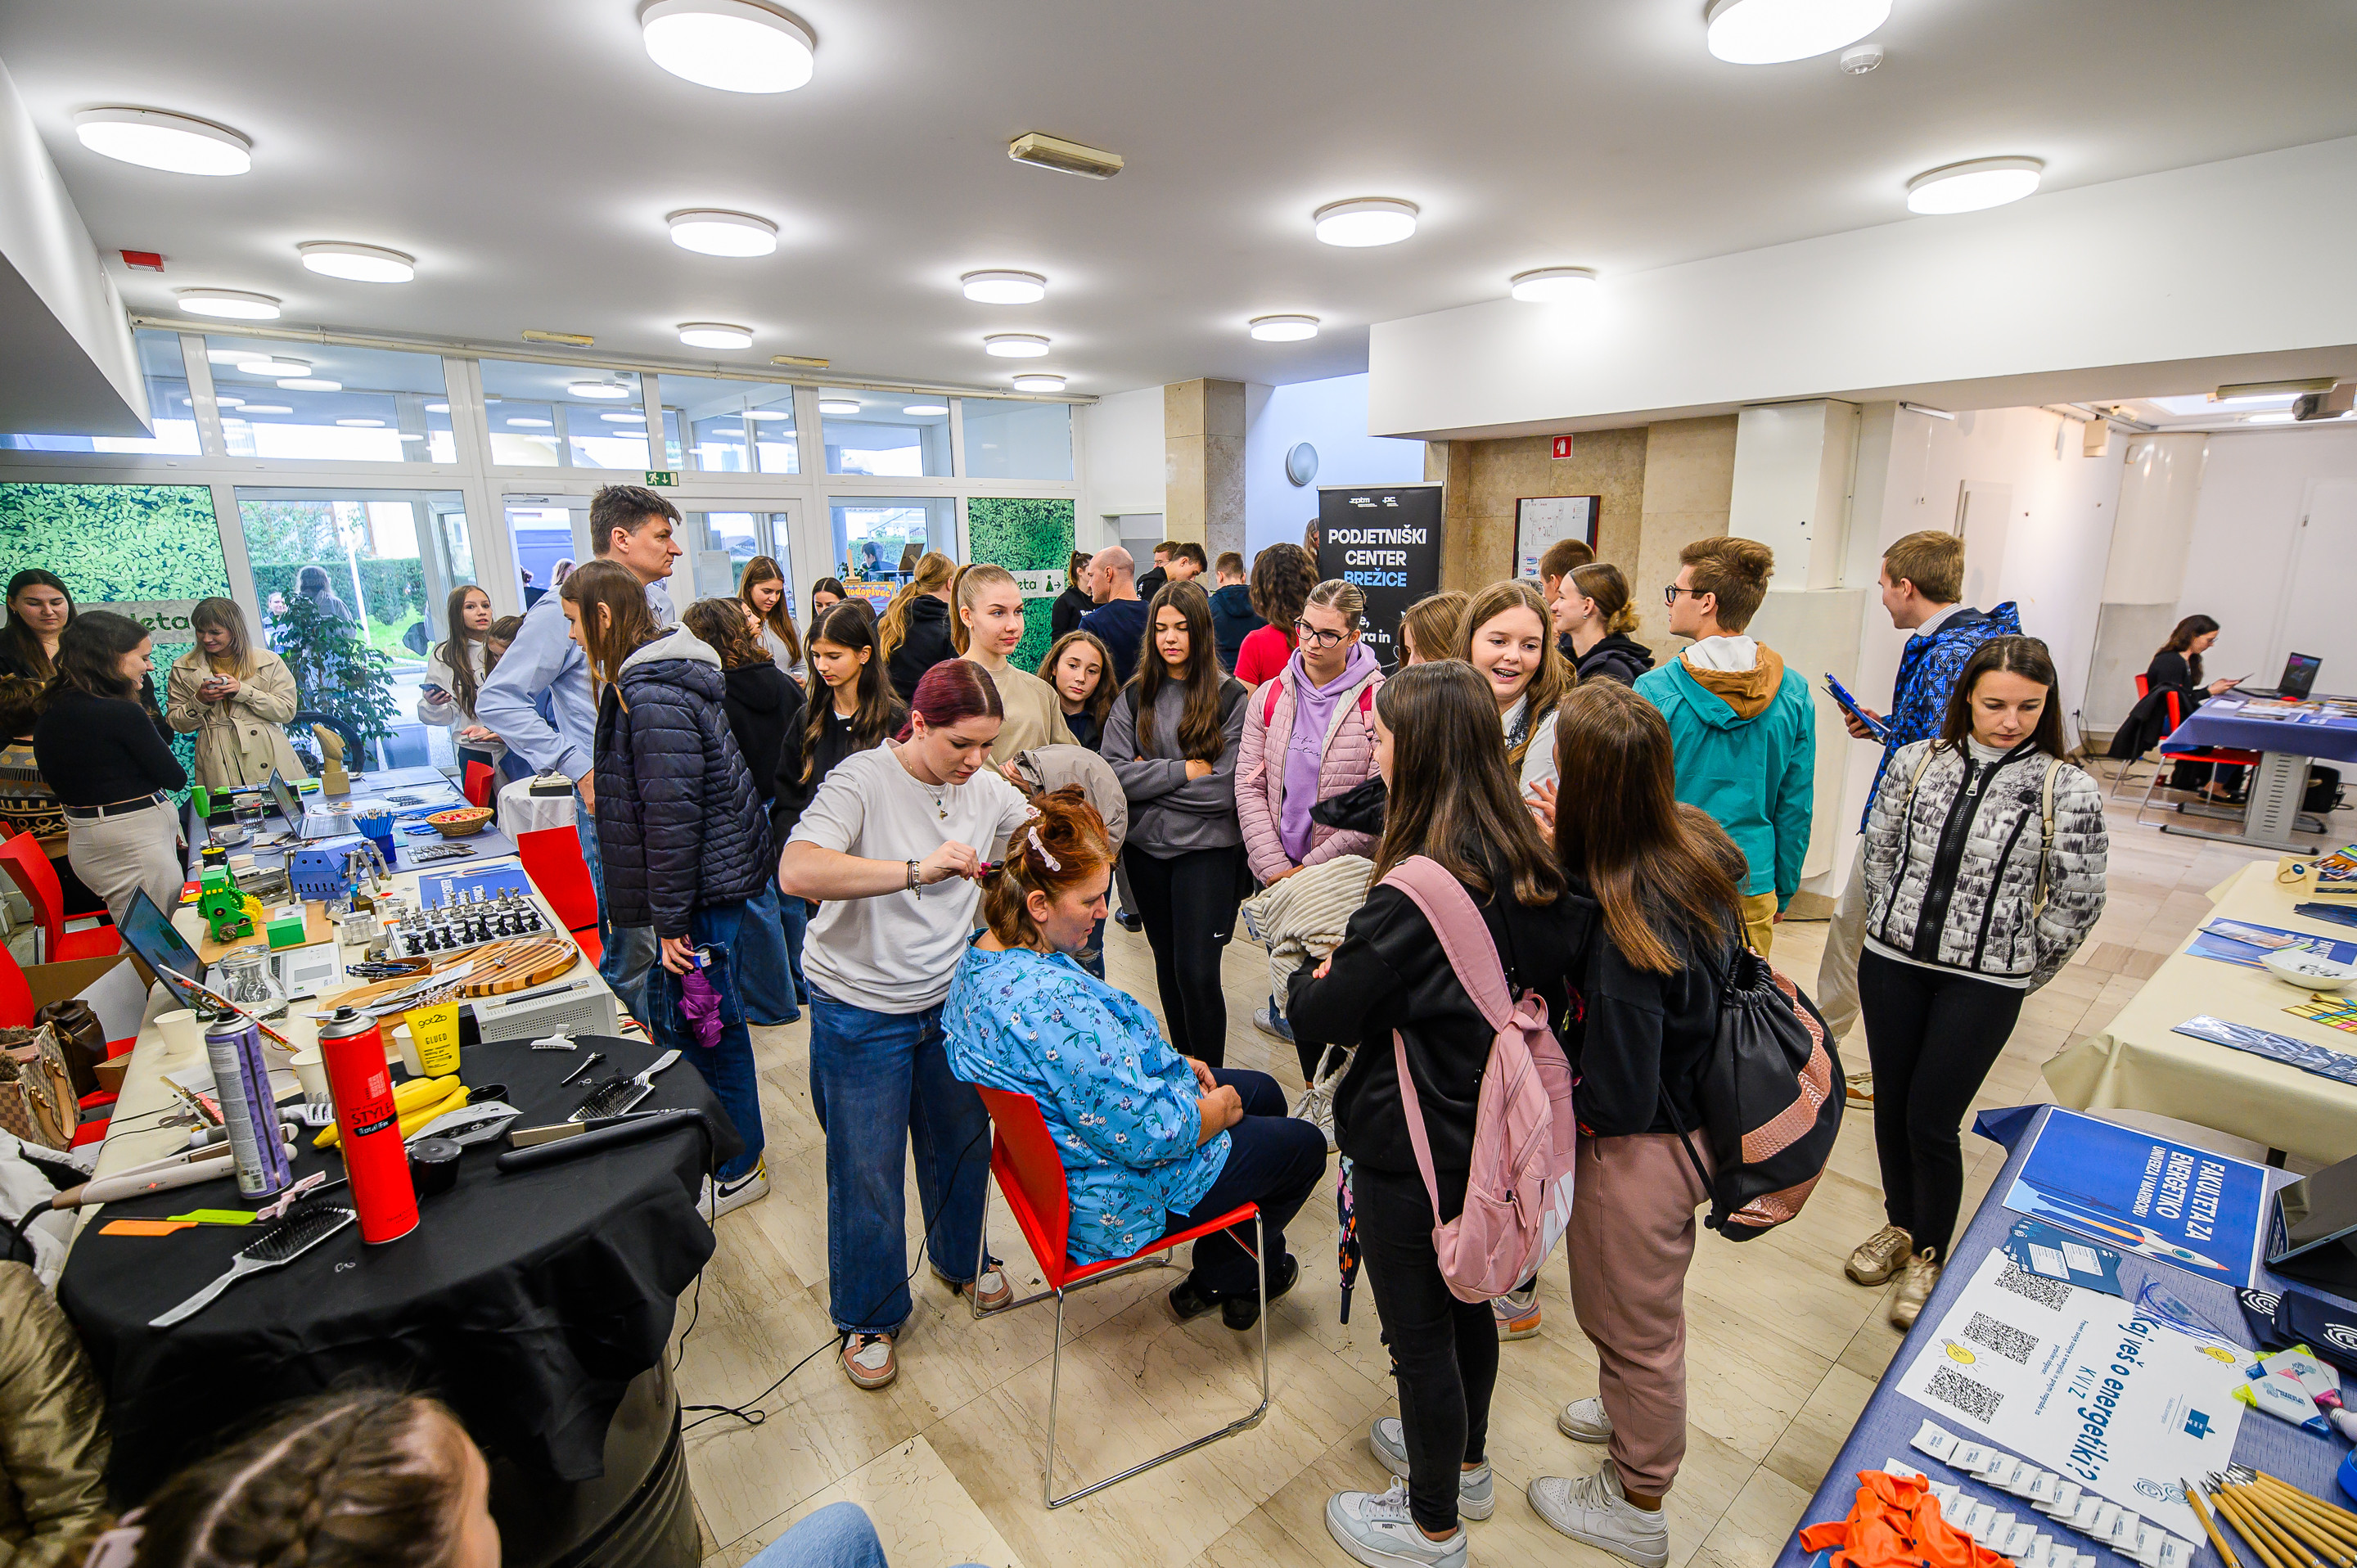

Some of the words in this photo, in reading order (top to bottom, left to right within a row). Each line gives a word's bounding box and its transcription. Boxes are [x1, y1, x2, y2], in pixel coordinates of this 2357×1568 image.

[1328, 524, 1427, 544] PODJETNIŠKI
[1345, 550, 1408, 566] CENTER
[1344, 567, 1408, 588] BREŽICE
[1378, 629, 1390, 643] in
[418, 1014, 448, 1030] got2b
[426, 1033, 448, 1045] GLUED
[2144, 1145, 2166, 1178] UNIVERZA
[2155, 1151, 2195, 1219] ENERGETIKO
[2188, 1160, 2226, 1223] FAKULTETA
[2131, 1179, 2157, 1219] MARIBORU
[2184, 1220, 2213, 1241] ZA
[2117, 1310, 2160, 1342] Kaj
[2116, 1337, 2145, 1368] veš
[2067, 1365, 2097, 1399] KVIZ
[2110, 1363, 2130, 1376] o
[2065, 1377, 2125, 1481] energetiki?
